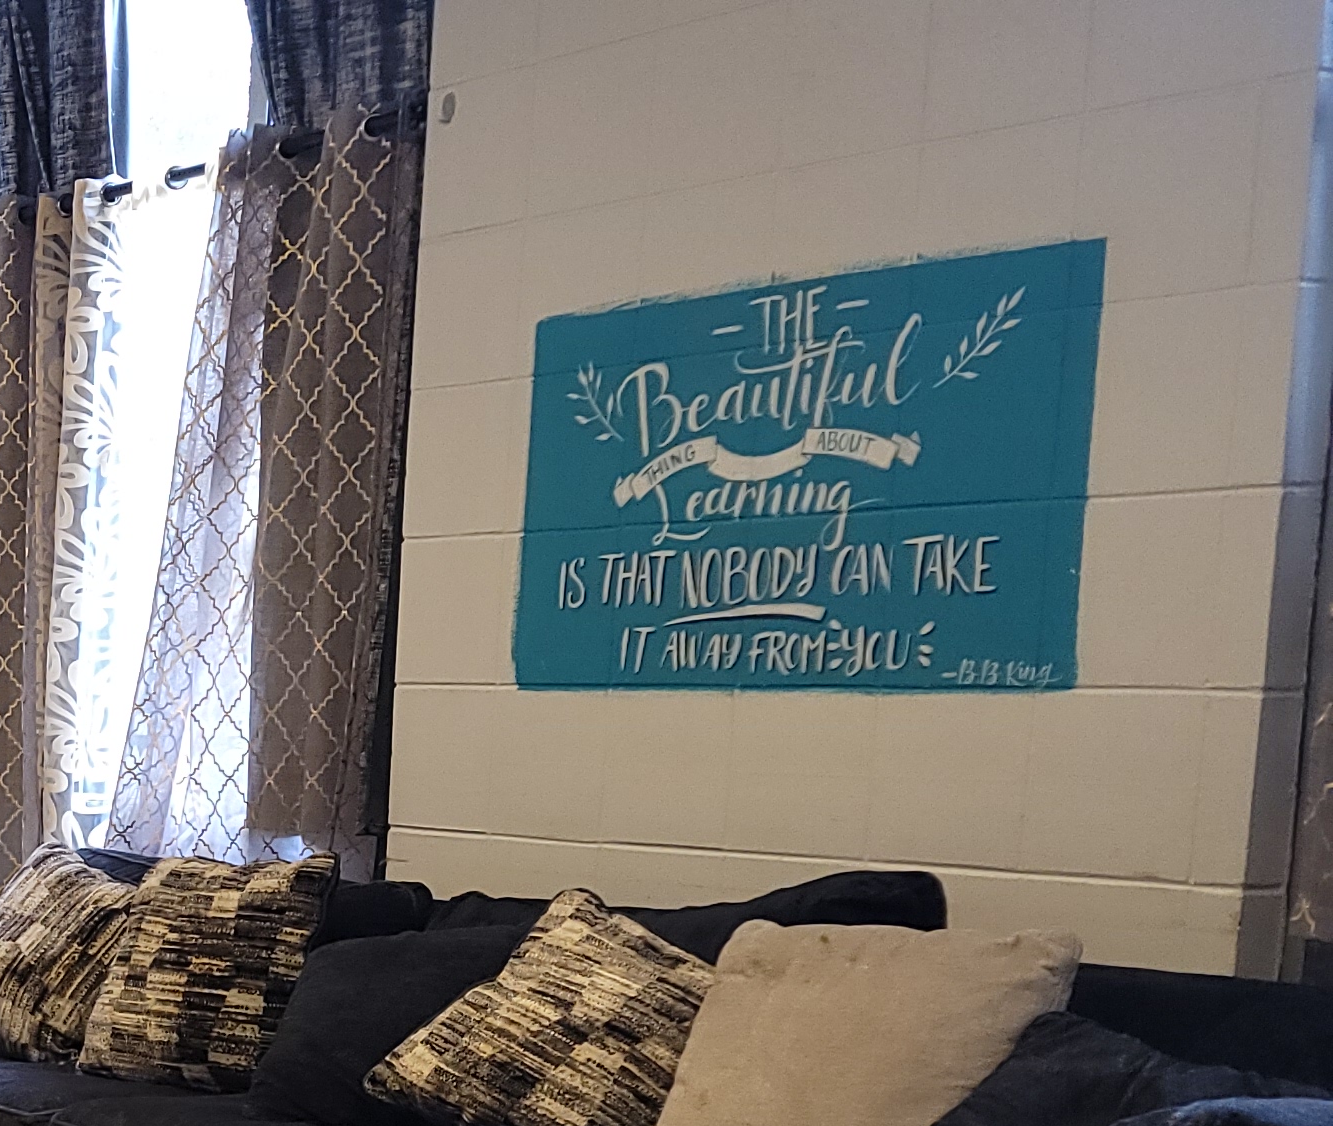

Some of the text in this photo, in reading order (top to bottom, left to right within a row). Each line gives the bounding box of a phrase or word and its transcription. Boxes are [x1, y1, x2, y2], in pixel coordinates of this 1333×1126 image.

[747, 284, 827, 354] THE
[617, 313, 922, 457] Beautiful
[643, 430, 875, 486] THING ABOUT
[652, 468, 878, 551] Learning
[558, 533, 1001, 610] IS THAT NOBODY CAN TAKE
[620, 625, 912, 677] IT AWAY FROM YOU
[1005, 660, 1062, 687] King
